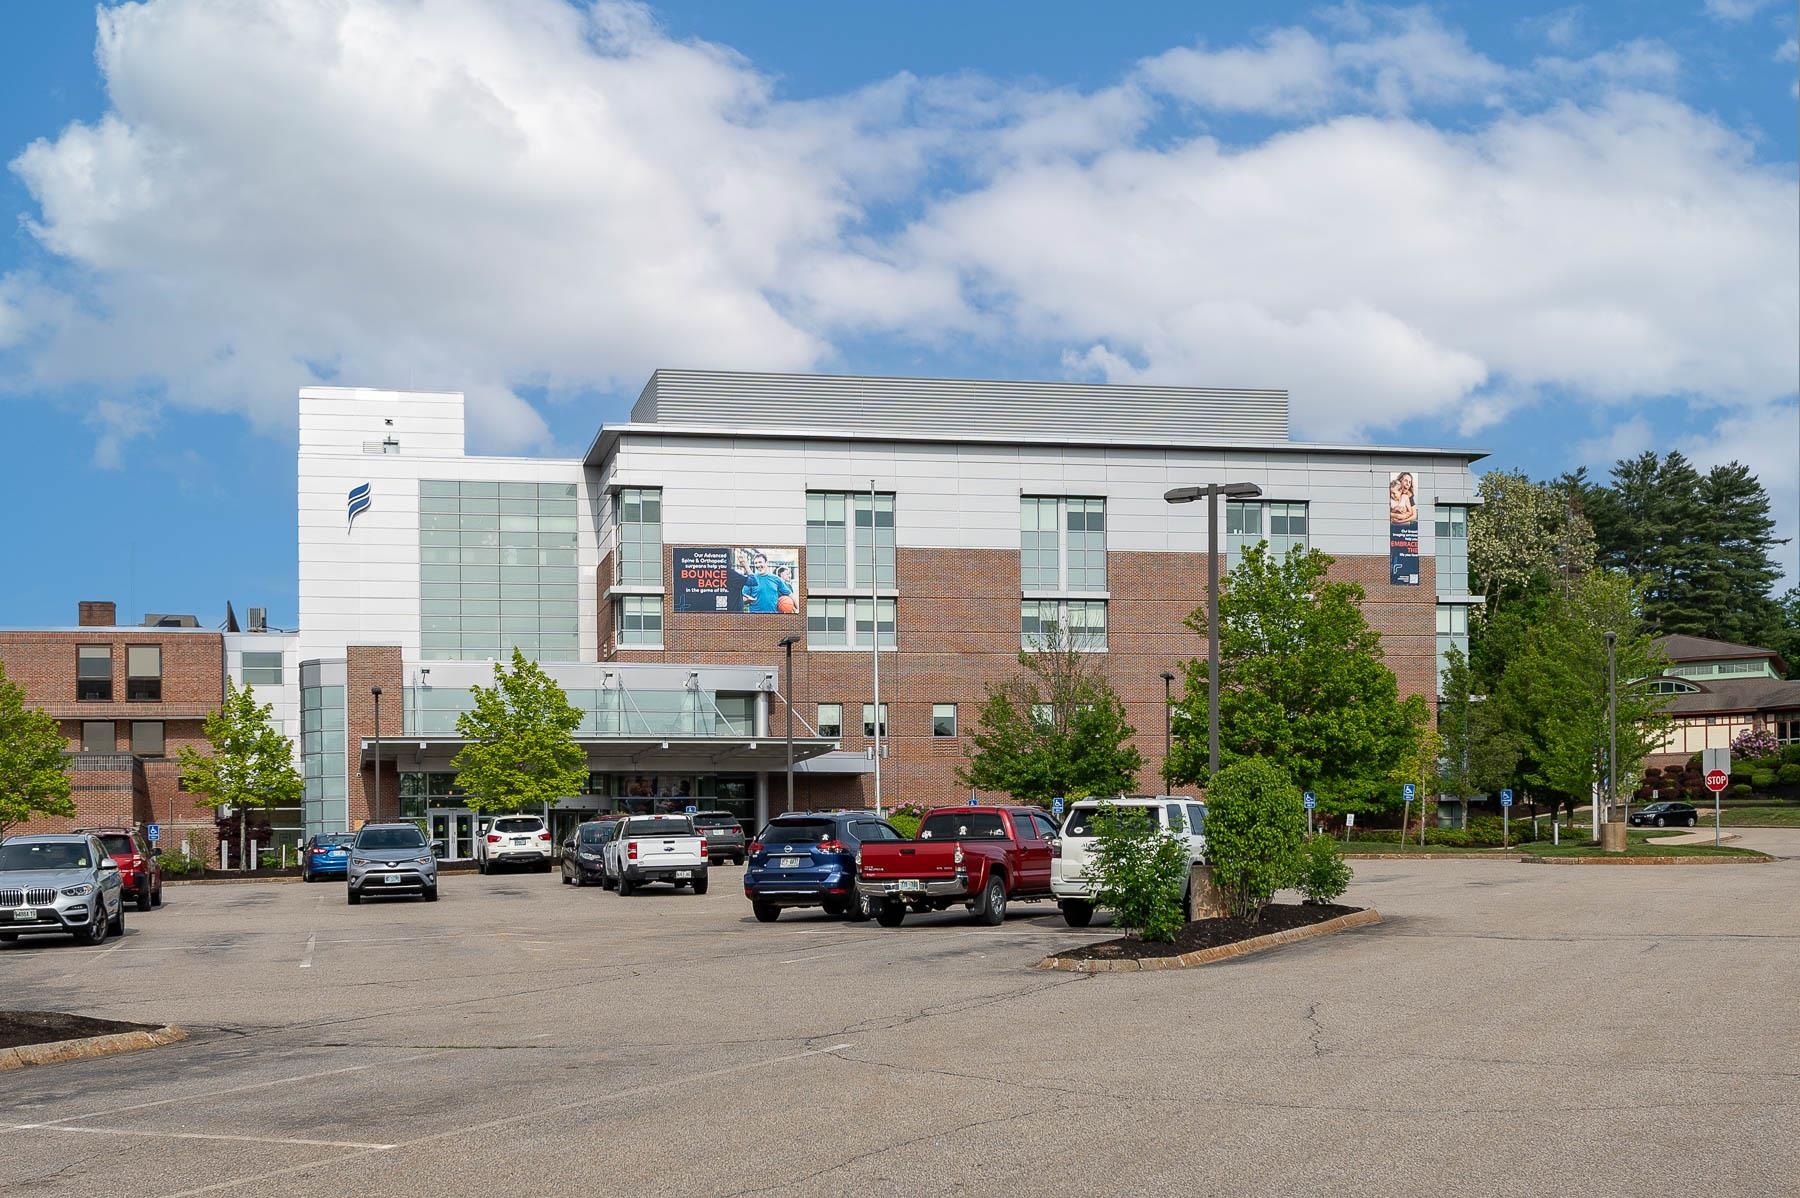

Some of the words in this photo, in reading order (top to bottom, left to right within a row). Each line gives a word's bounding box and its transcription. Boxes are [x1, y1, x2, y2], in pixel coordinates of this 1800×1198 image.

[681, 569, 728, 579] BOUNCE
[698, 579, 728, 588] BACK
[1707, 775, 1726, 785] STOP
